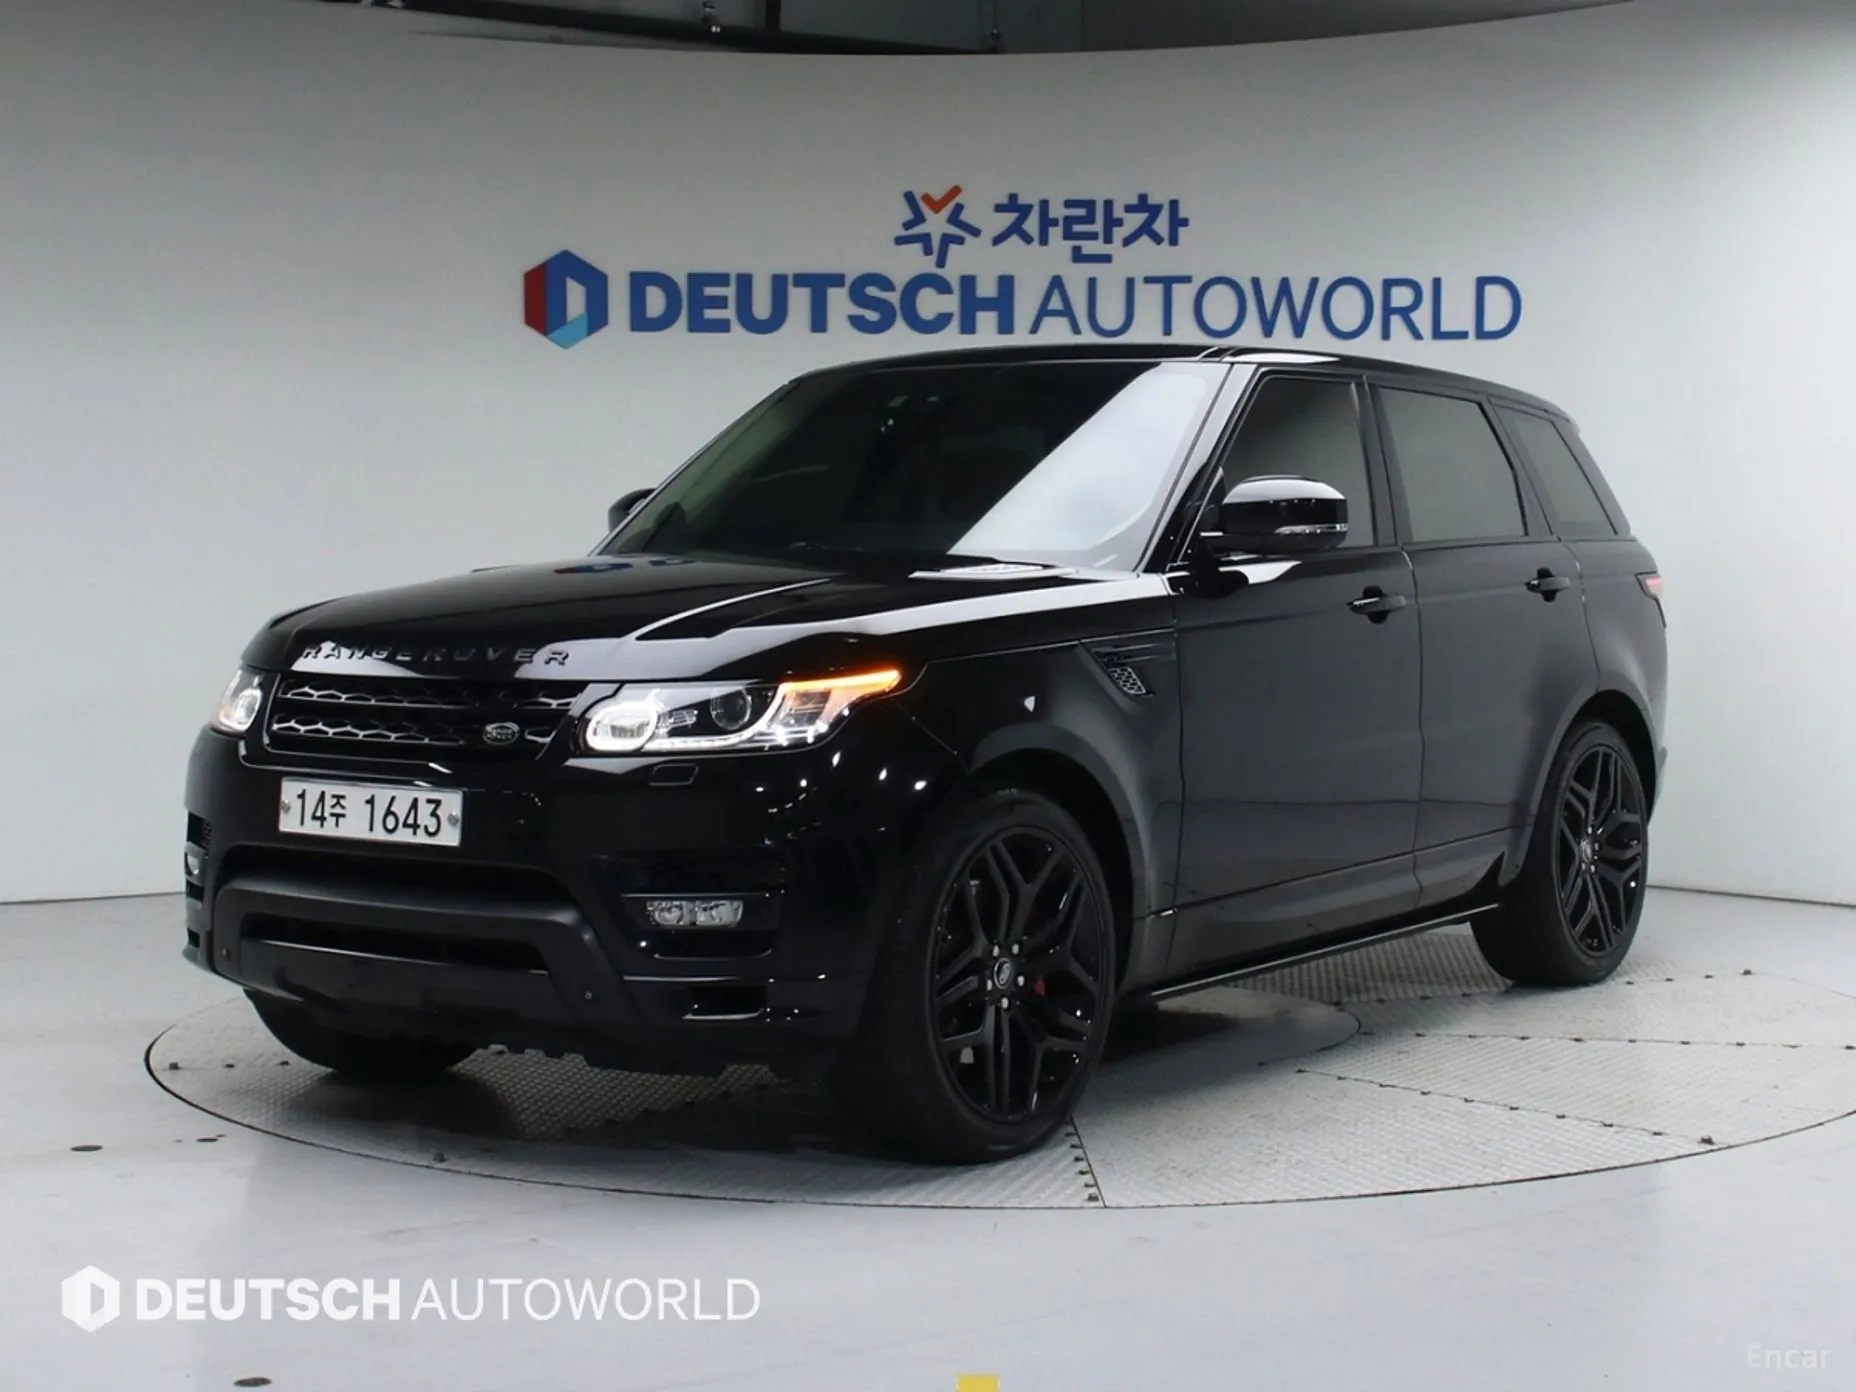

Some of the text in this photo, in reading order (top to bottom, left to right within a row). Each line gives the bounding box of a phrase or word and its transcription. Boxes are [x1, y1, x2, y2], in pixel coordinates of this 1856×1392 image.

[992, 193, 1189, 263] 차란차
[628, 270, 1523, 342] DEUTSCH AUTOWORLD
[302, 642, 413, 662] RANGE
[296, 788, 443, 837] 14주 1643
